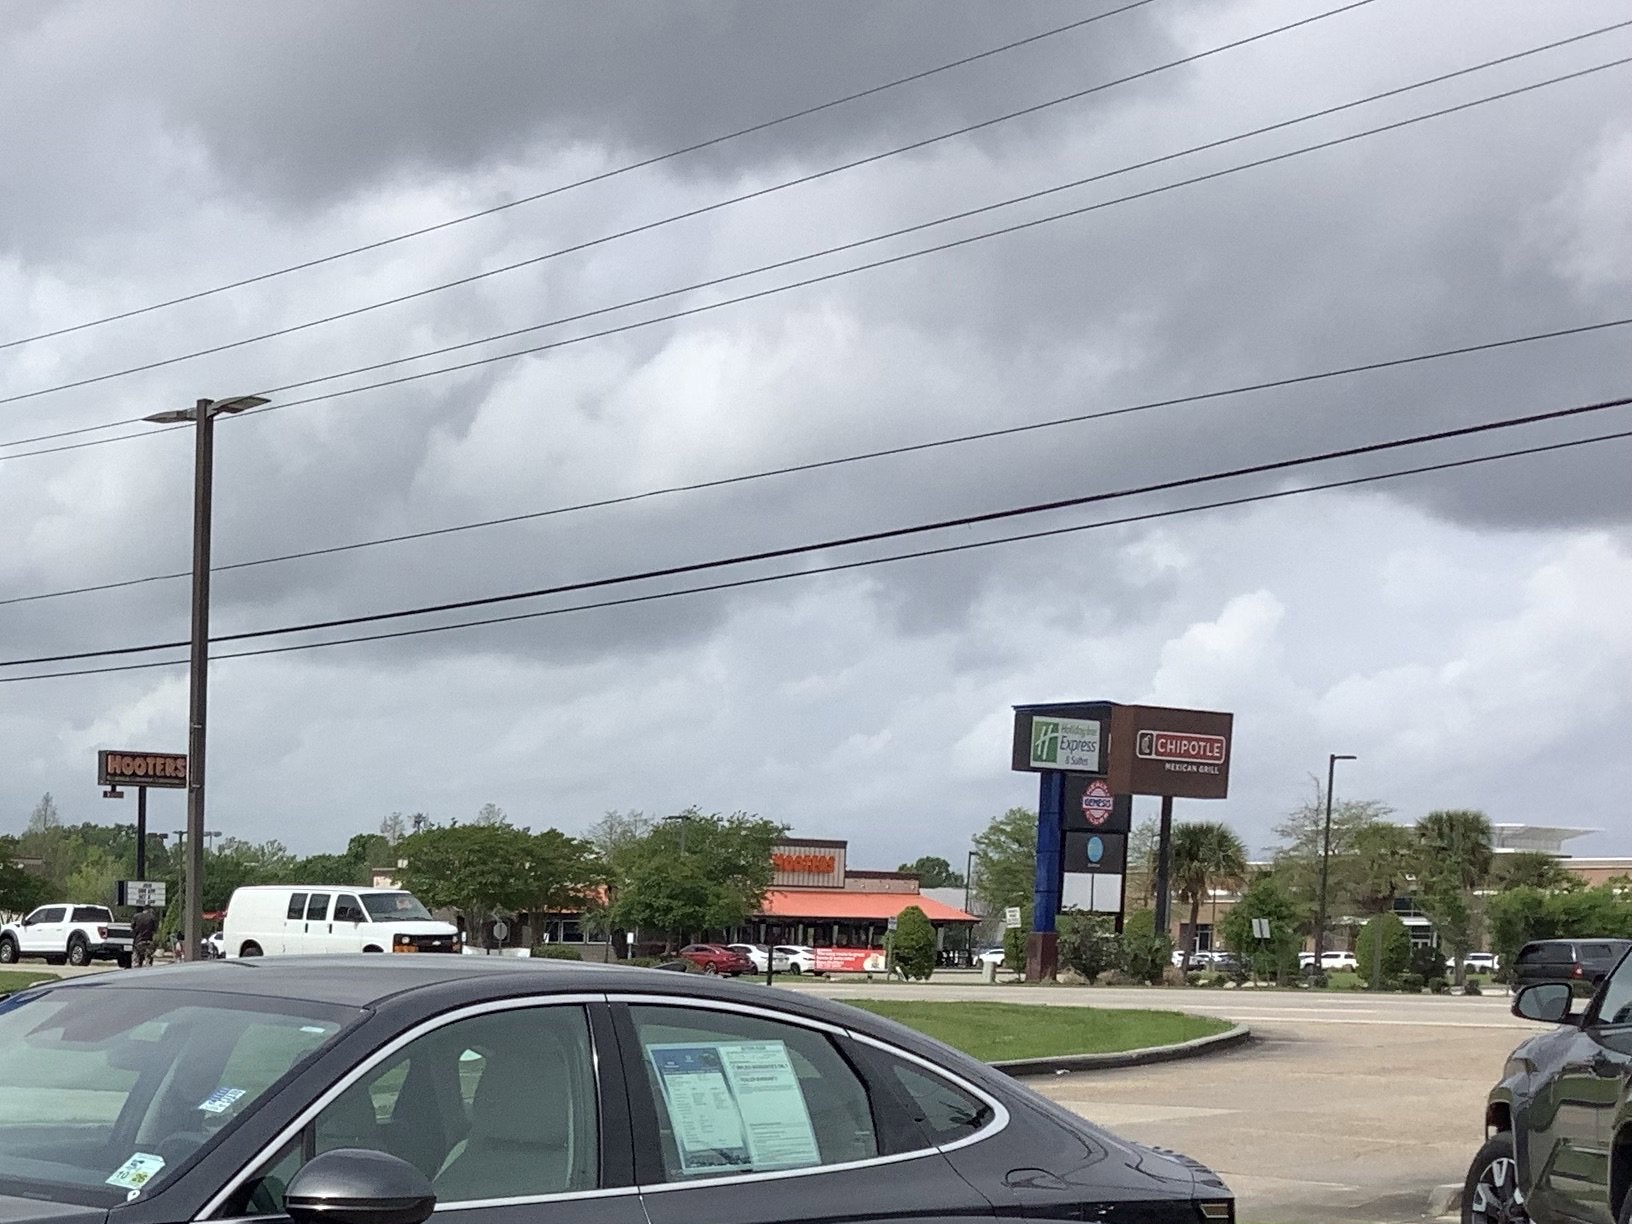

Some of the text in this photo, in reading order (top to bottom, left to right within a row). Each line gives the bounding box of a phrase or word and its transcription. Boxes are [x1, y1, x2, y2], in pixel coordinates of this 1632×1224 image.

[1060, 735, 1097, 755] Express
[1157, 738, 1221, 757] CHIPOTLE
[108, 754, 186, 778] HOOTERS
[1165, 762, 1219, 775] MEXICAN GRILL
